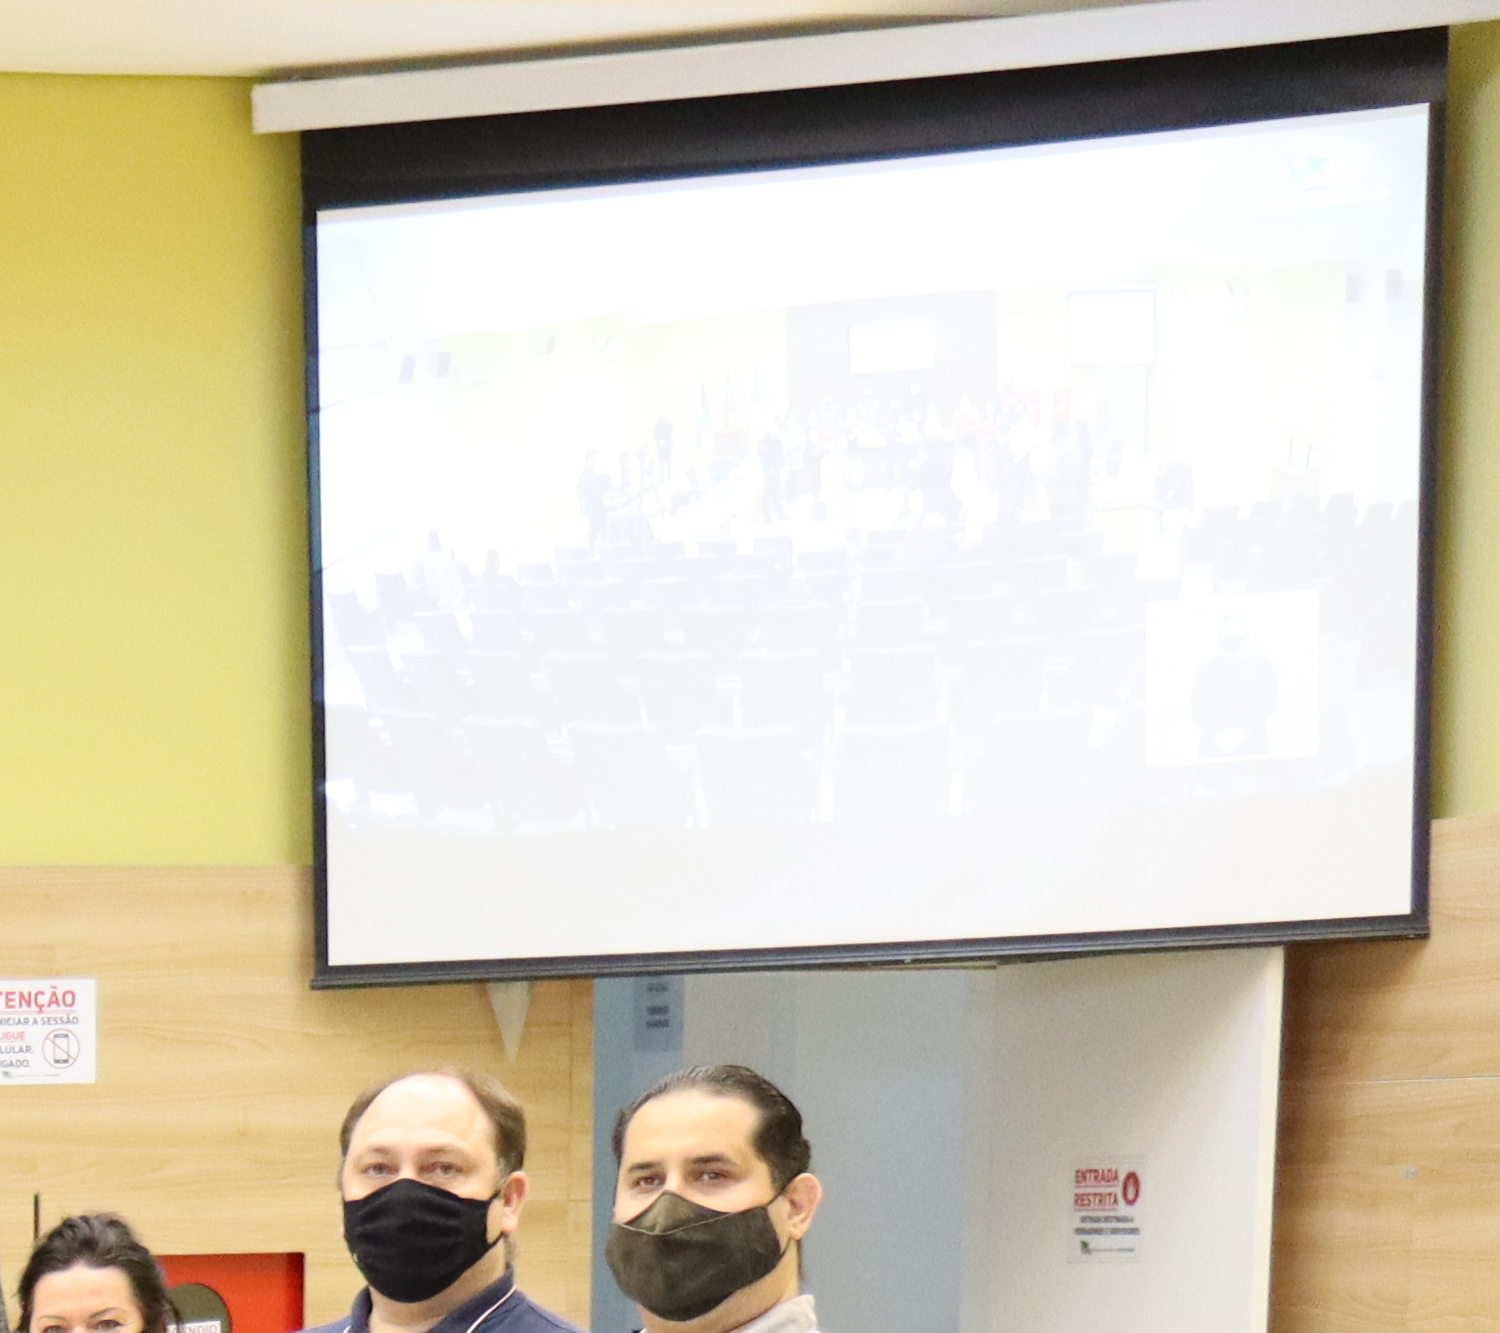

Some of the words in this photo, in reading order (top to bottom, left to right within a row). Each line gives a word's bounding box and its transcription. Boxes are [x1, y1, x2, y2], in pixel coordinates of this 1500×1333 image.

[32, 1016, 39, 1026] A
[40, 1013, 79, 1026] SESSÃO
[1074, 1168, 1119, 1184] ENTRADA
[1074, 1192, 1119, 1208] RESTRITA
